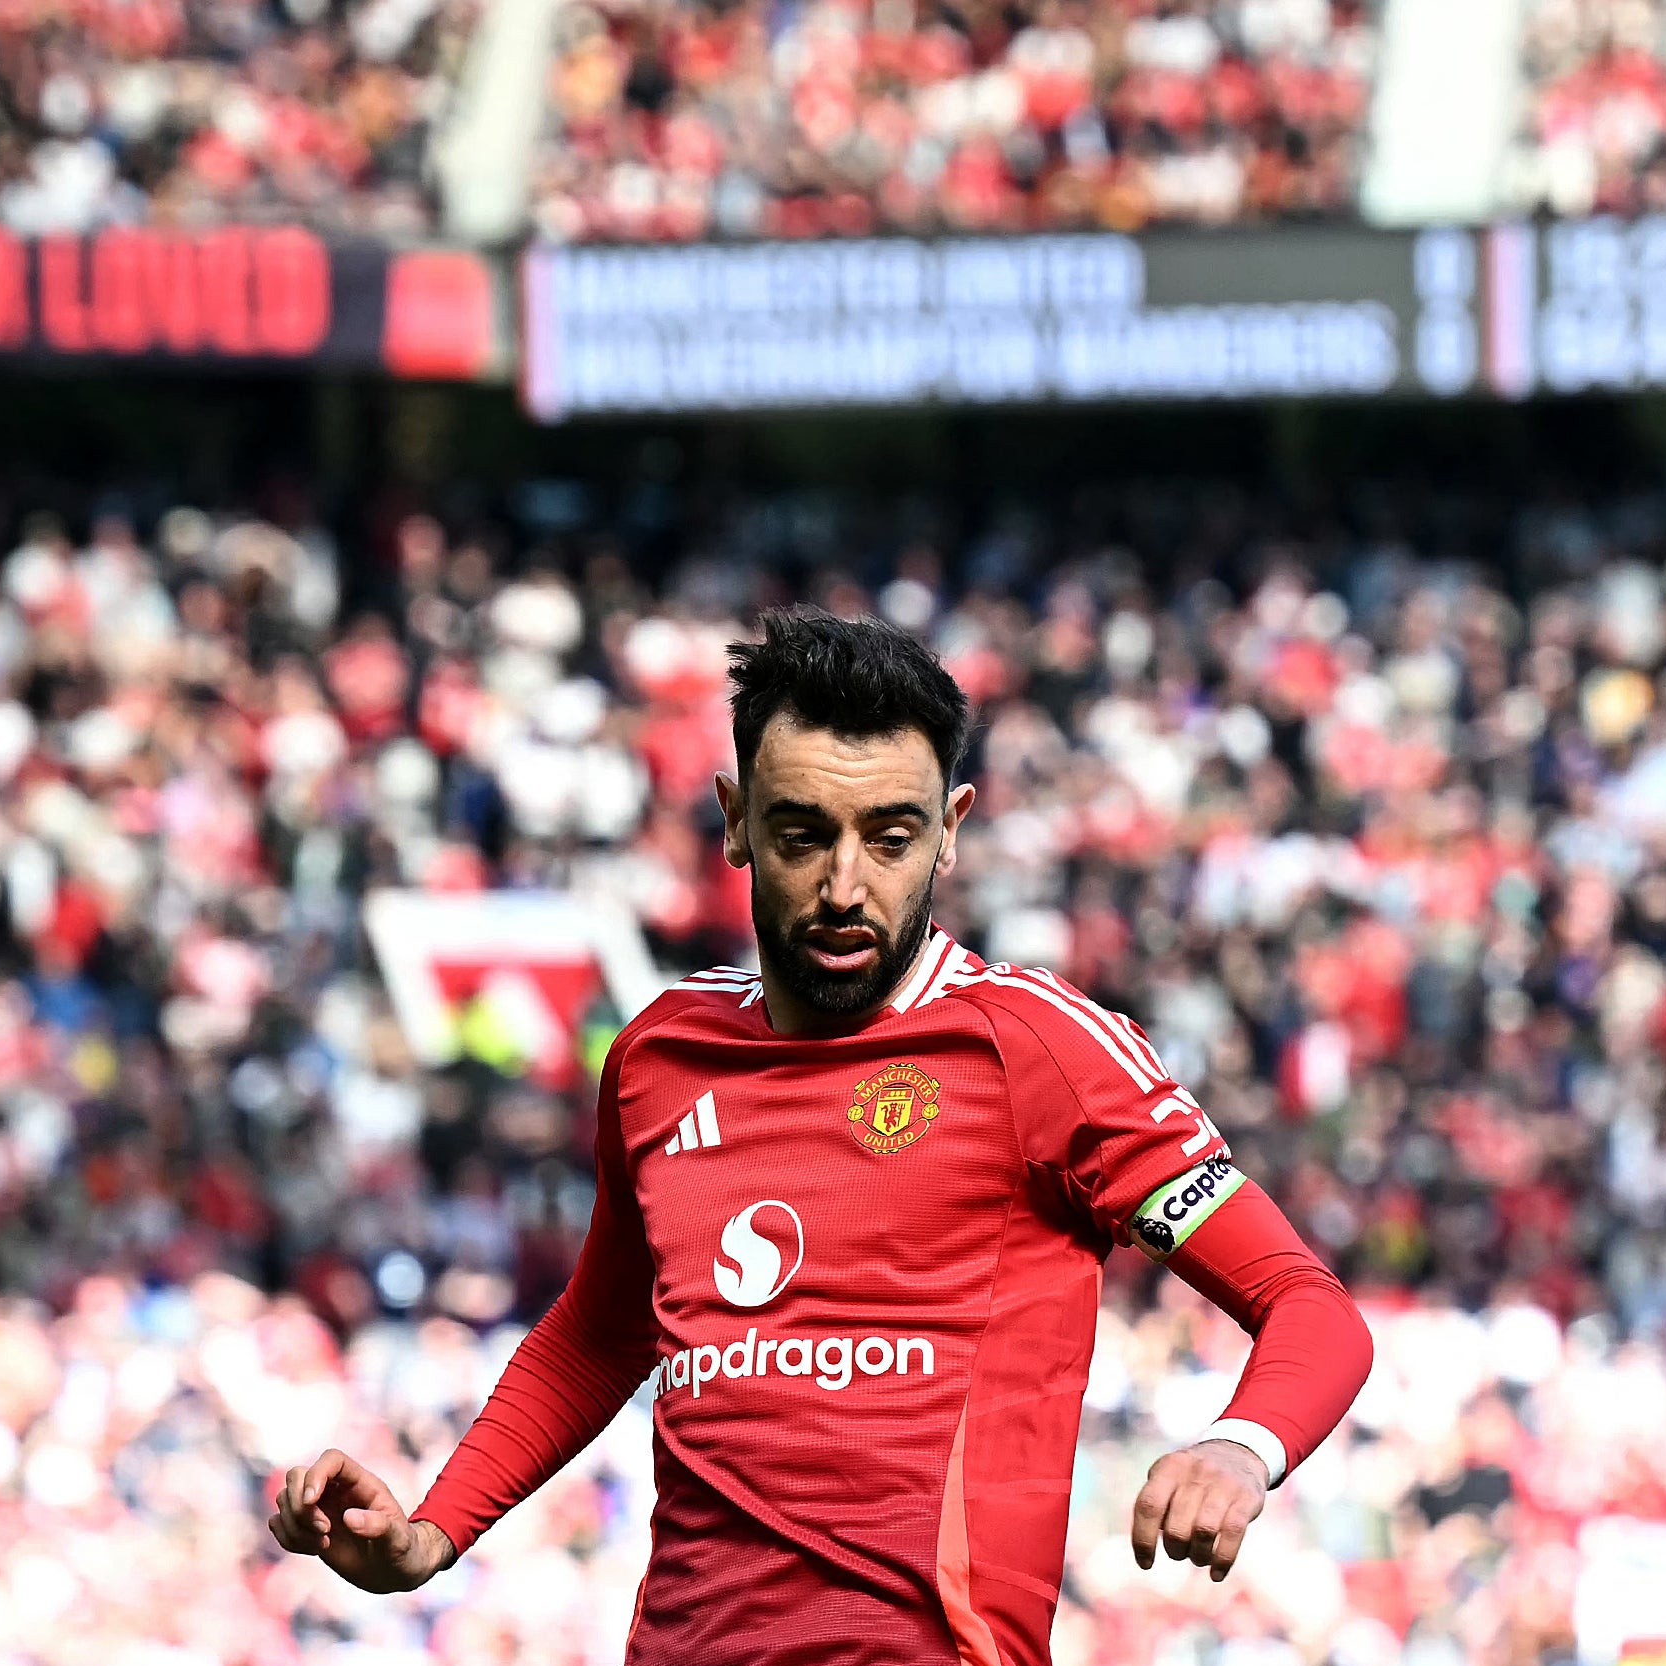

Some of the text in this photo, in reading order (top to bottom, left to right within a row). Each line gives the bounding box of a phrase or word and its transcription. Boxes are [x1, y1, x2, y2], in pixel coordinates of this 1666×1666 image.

[860, 1070, 933, 1100] MANCHESTER
[863, 1131, 915, 1148] UNITED
[1163, 1158, 1232, 1222] Capta
[654, 1327, 935, 1399] napdragon
